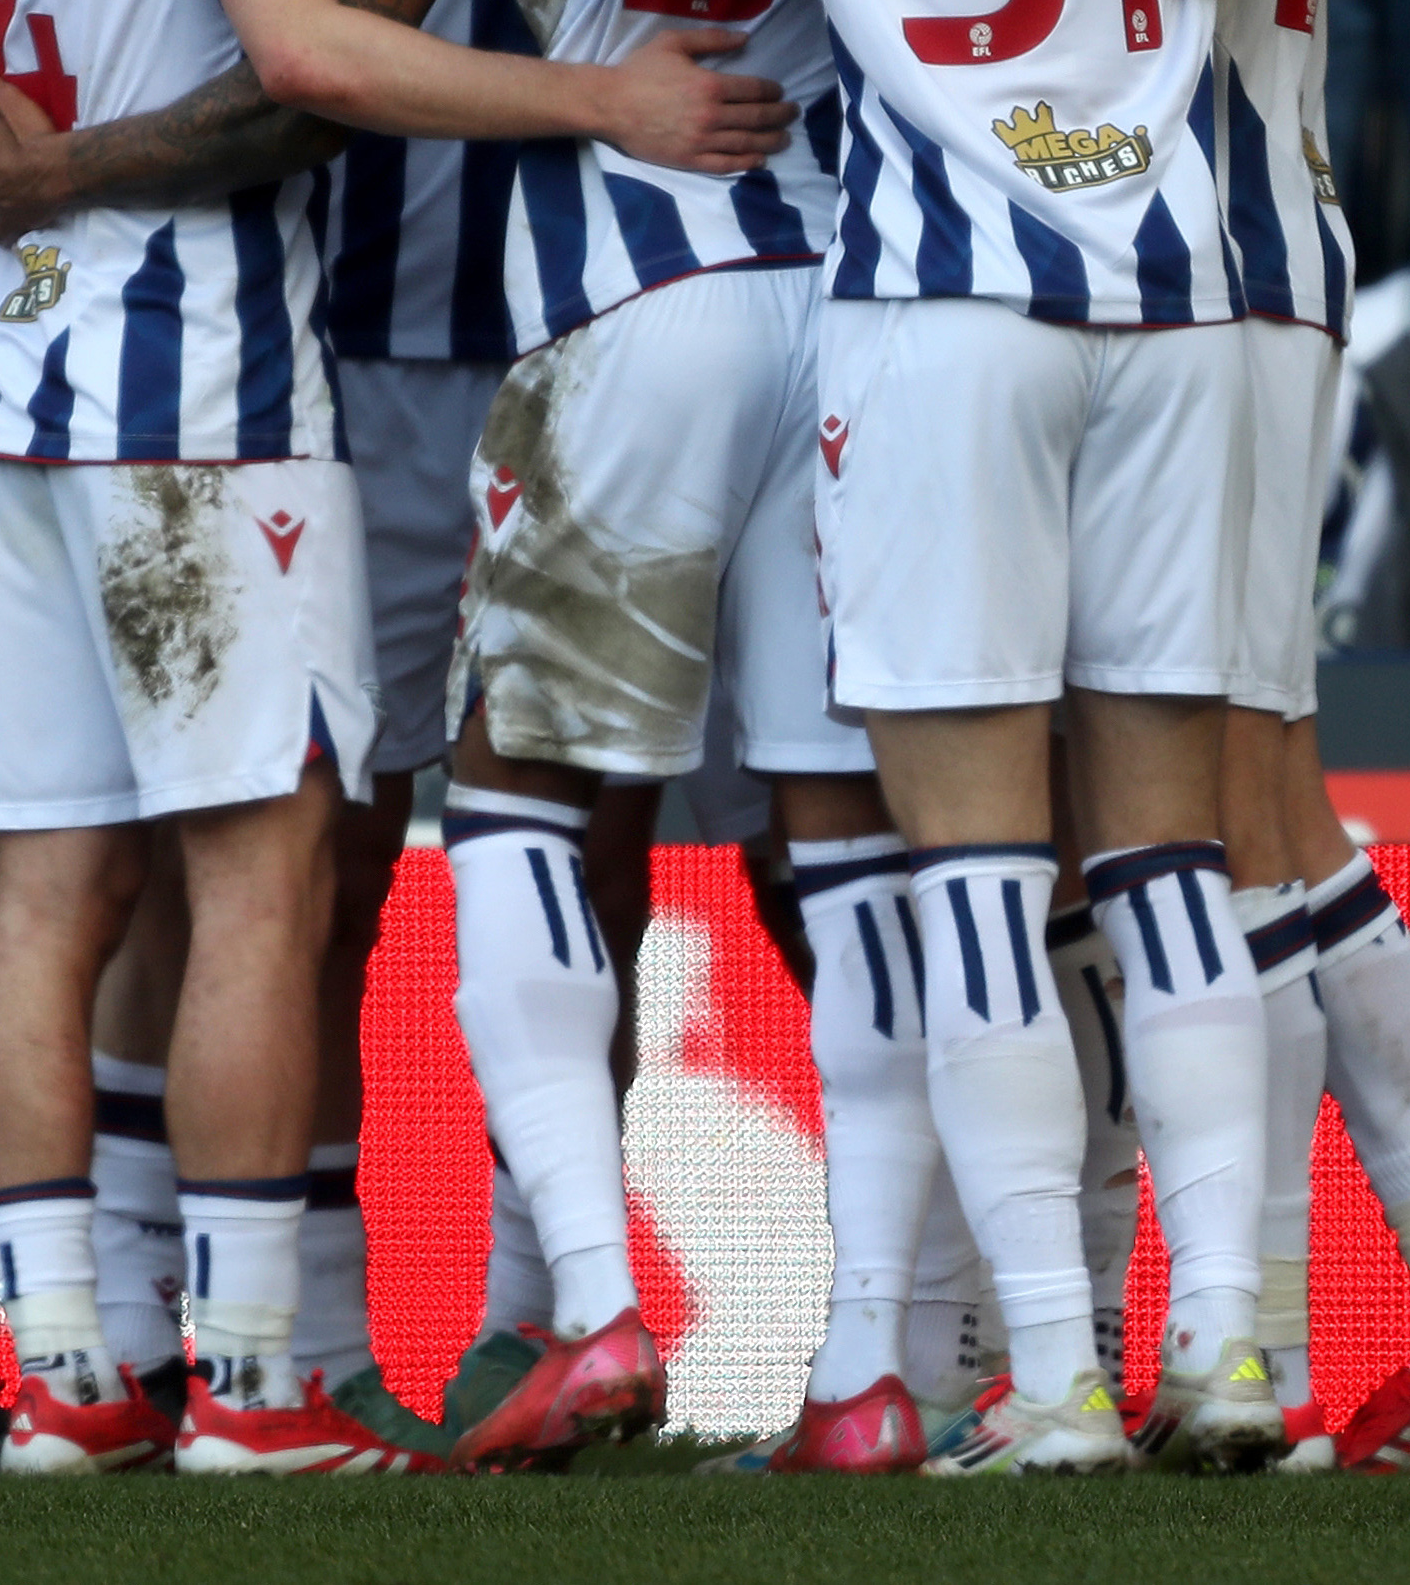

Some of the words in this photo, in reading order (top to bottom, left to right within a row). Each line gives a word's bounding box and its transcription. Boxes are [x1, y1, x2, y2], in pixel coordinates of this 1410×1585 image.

[1135, 32, 1149, 43] EFL
[972, 46, 992, 57] EFL
[1014, 123, 1127, 161] MEGA
[1024, 144, 1139, 186] RICHES
